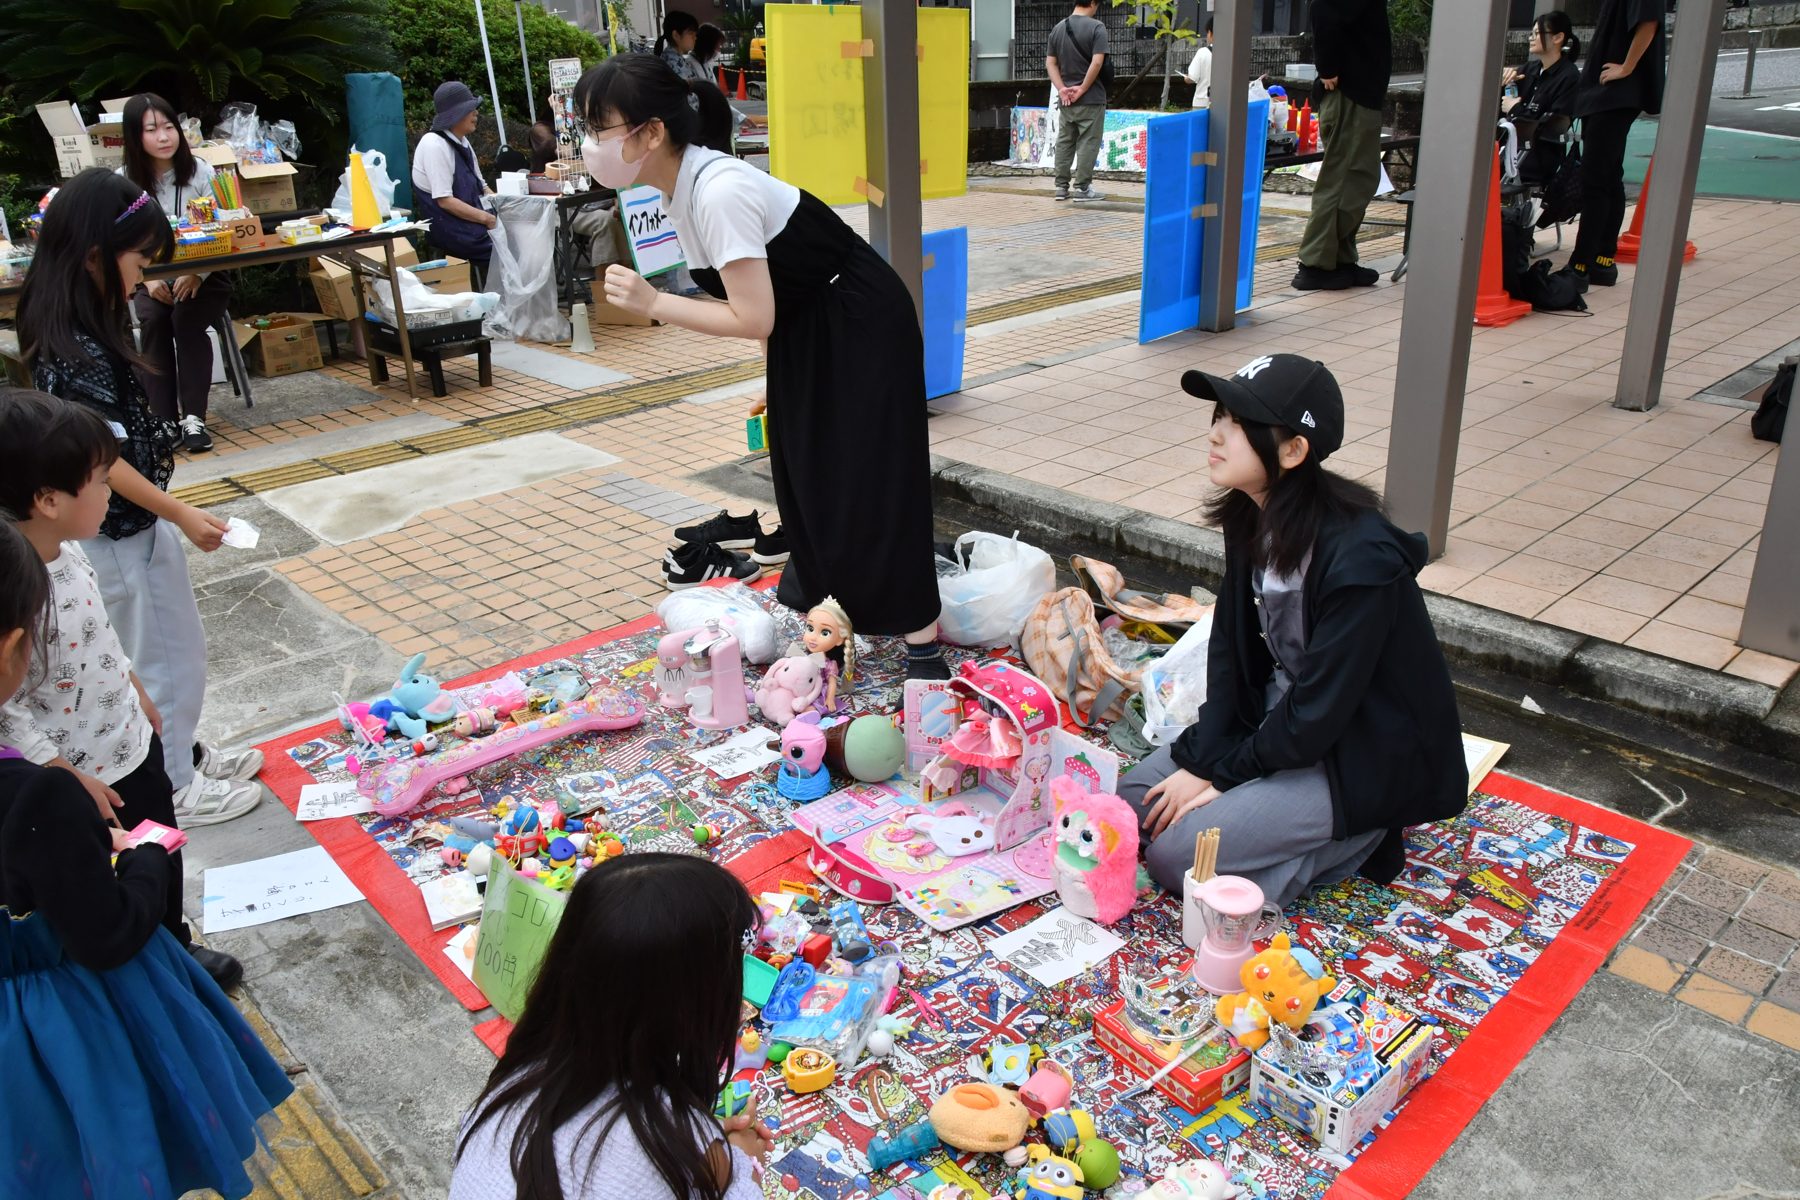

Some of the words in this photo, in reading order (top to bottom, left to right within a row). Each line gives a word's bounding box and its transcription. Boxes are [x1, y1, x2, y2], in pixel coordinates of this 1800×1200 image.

[235, 224, 256, 239] 50
[629, 207, 672, 238] インフォメー
[1596, 255, 1615, 267] DIC
[1236, 355, 1273, 380] NY
